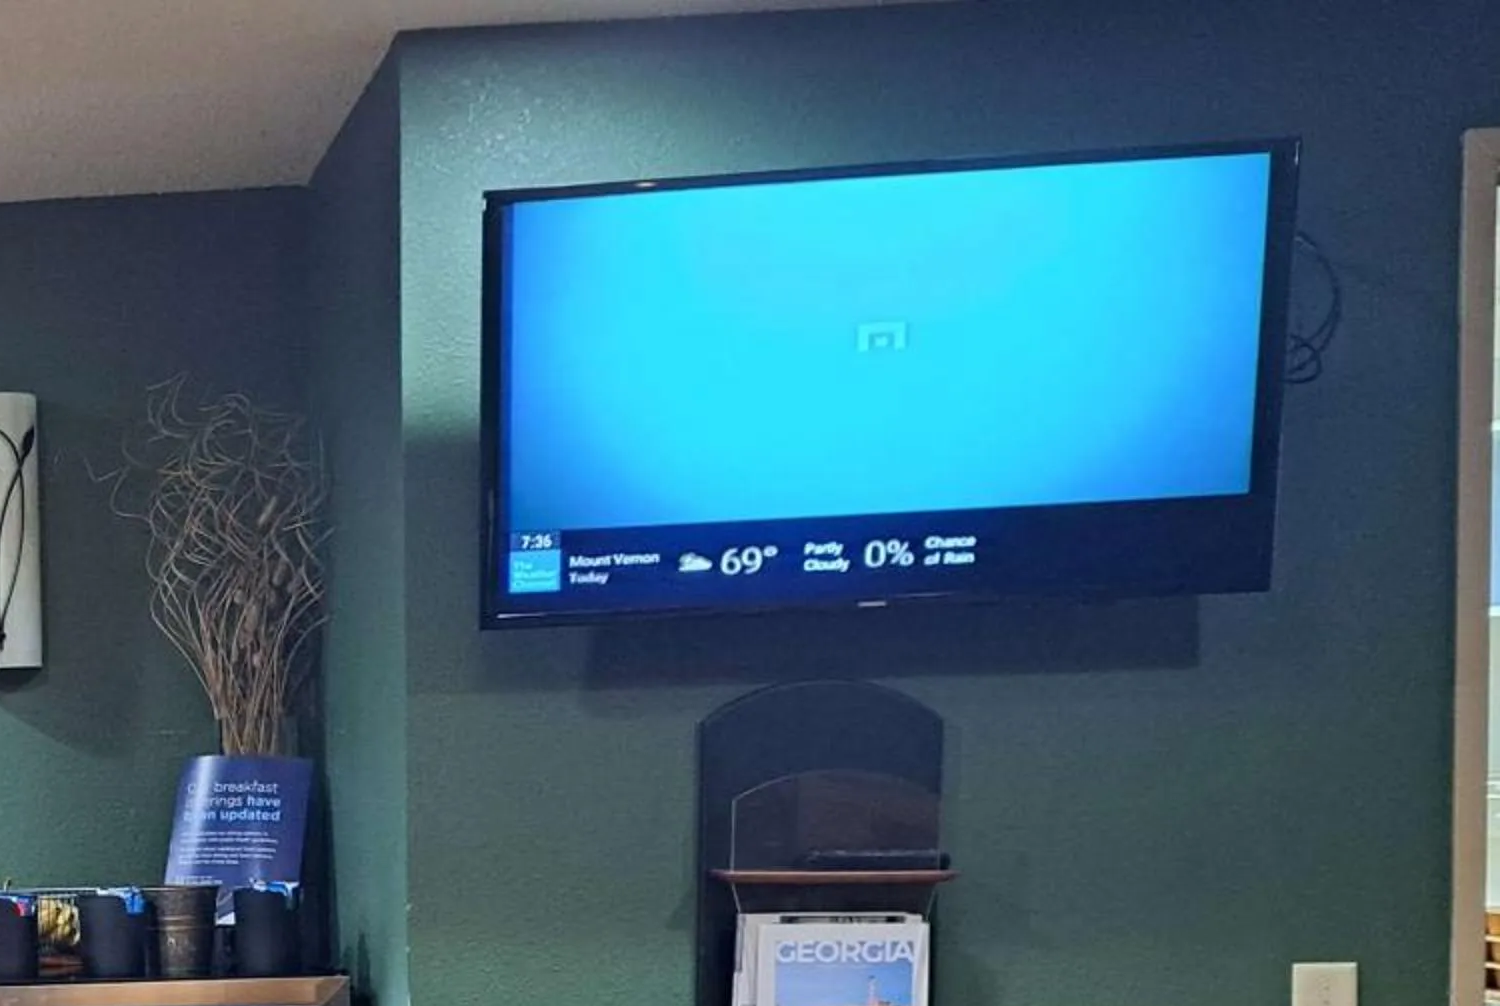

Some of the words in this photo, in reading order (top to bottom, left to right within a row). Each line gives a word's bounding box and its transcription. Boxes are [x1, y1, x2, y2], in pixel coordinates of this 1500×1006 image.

[521, 533, 552, 549] 7:36
[803, 541, 844, 556] Partly
[924, 535, 977, 550] Chance
[569, 554, 611, 568] Mount
[613, 552, 660, 566] Vernon
[864, 539, 914, 568] 0%
[943, 551, 976, 565] Rain
[803, 557, 851, 573] Cloudy
[569, 571, 610, 585] Today
[213, 780, 279, 794] breakfast
[247, 794, 280, 807] have
[219, 808, 281, 823] updated
[776, 940, 914, 963] GEORGIA
